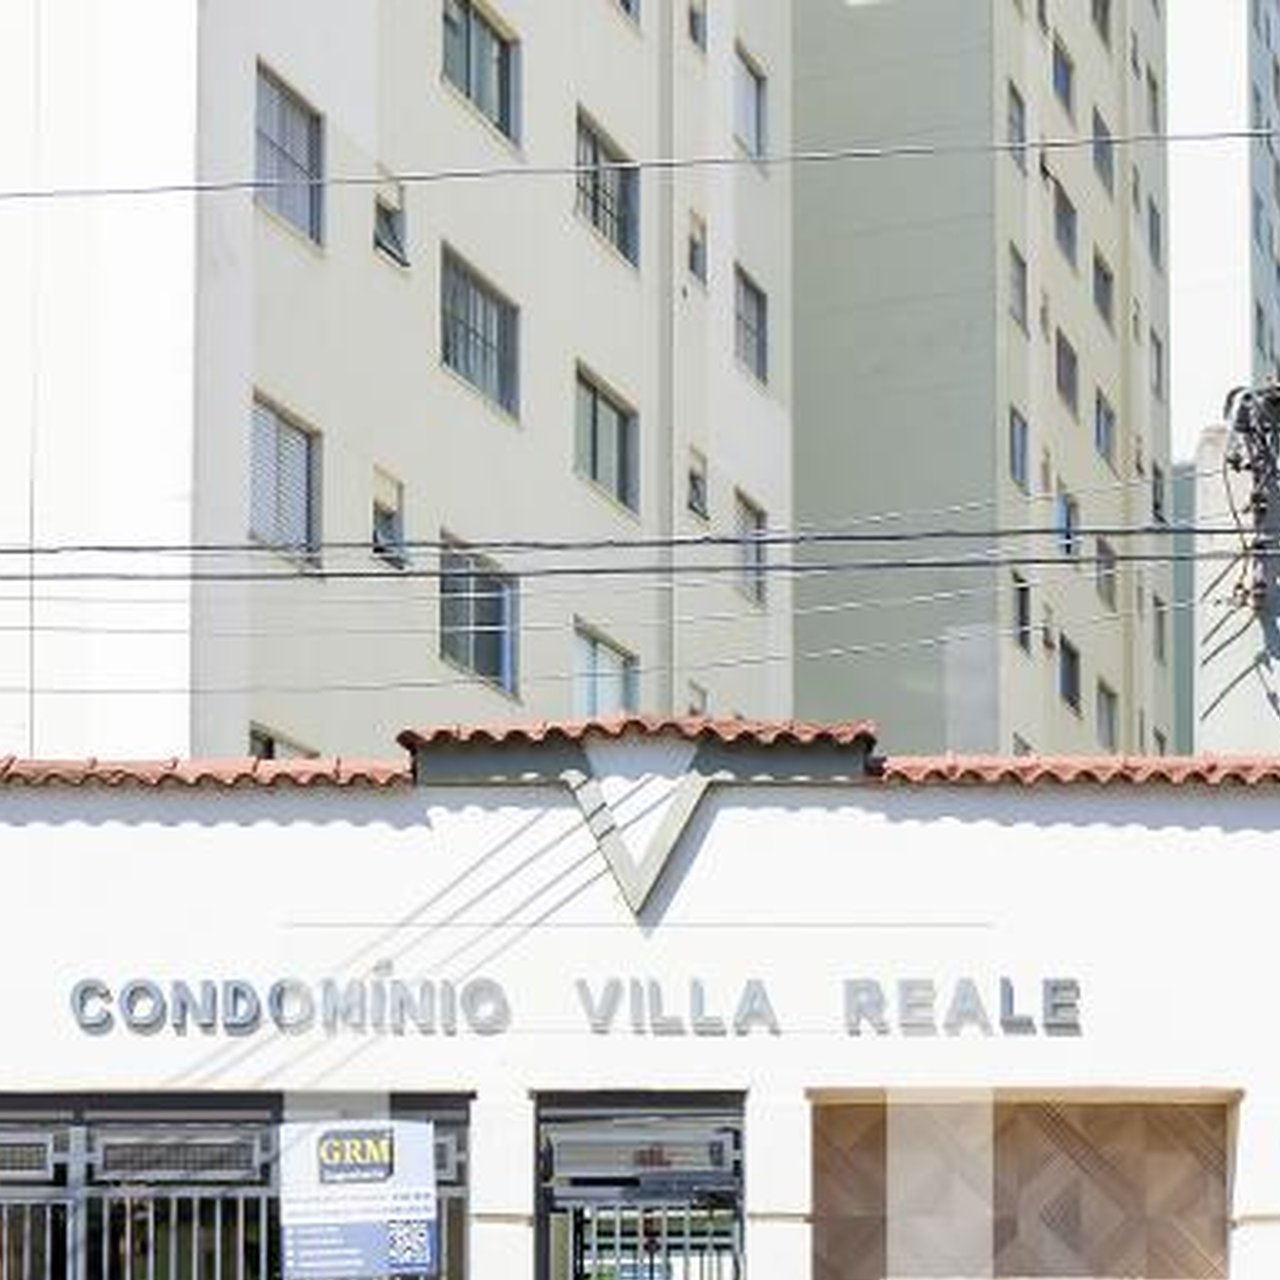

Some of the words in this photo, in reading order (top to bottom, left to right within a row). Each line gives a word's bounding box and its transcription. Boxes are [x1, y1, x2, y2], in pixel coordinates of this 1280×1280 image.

[70, 959, 512, 1037] CONDOMÍNIO
[575, 977, 782, 1037] VILLA
[842, 977, 1083, 1038] REALE
[319, 1138, 391, 1165] GRM
